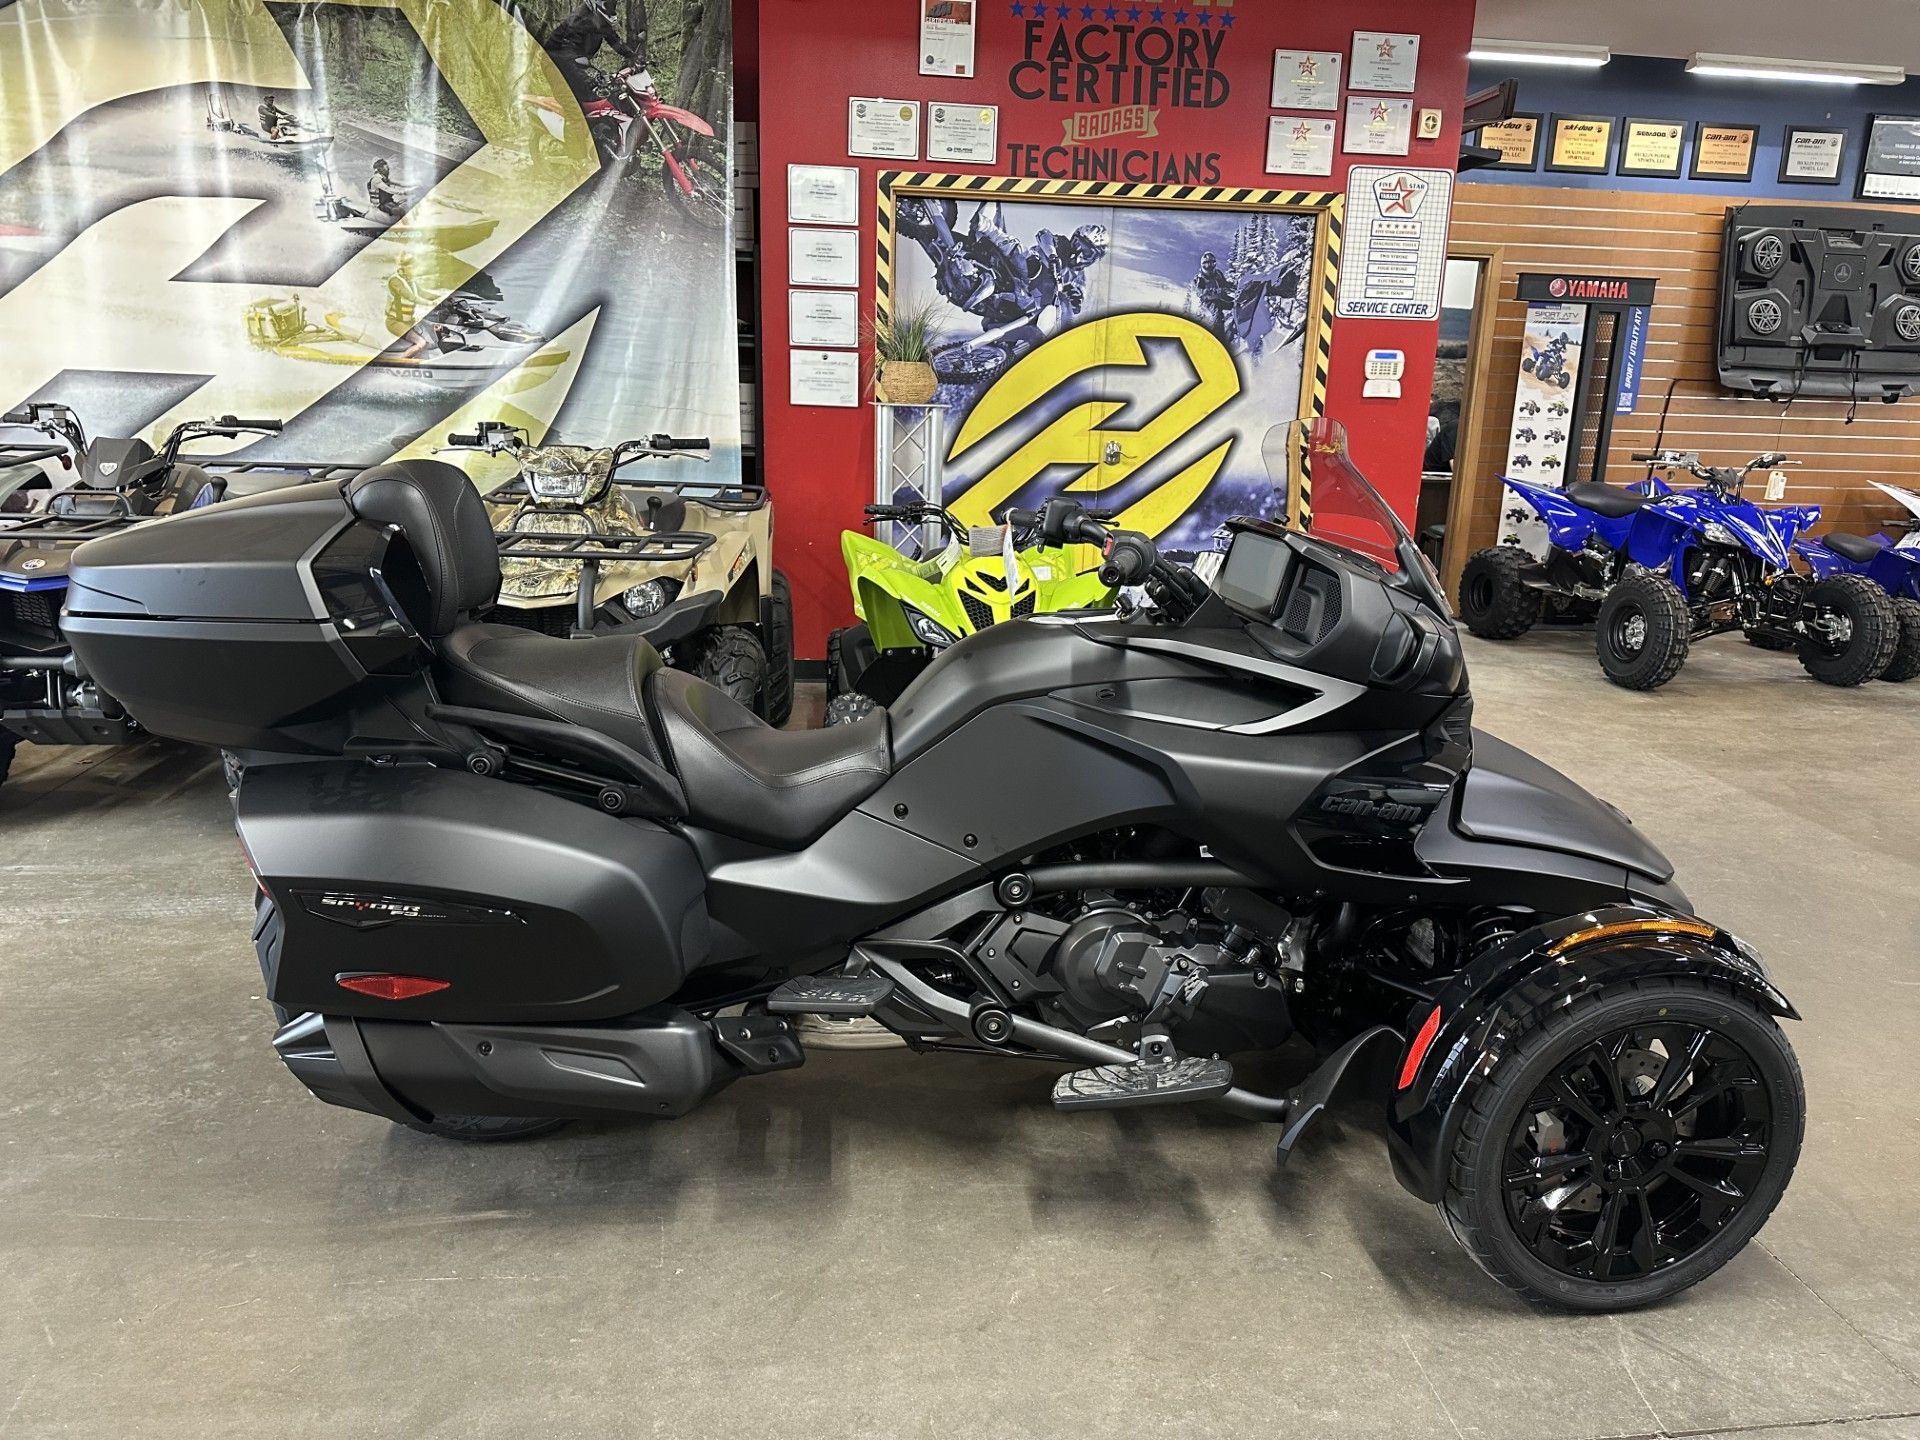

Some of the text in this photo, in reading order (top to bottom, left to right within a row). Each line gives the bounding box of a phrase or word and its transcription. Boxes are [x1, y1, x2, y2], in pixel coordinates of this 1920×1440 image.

[1024, 20, 1226, 68] FACTORY
[1008, 61, 1230, 108] CERTIFIED
[1077, 107, 1145, 137] BADASS
[1705, 133, 1737, 141] can-am
[1795, 137, 1827, 145] can-am
[1007, 143, 1221, 185] TECHNICIANS
[1378, 181, 1392, 189] FIVE
[1409, 182, 1425, 190] STAR
[1568, 280, 1629, 299] YAMAHA
[1346, 301, 1429, 315] SERVICE CENTER
[1624, 364, 1634, 389] SPORT
[1629, 326, 1641, 356] UTILITY
[1635, 308, 1643, 326] ATV
[1320, 796, 1422, 821] can-am
[321, 897, 421, 912] SPYDER
